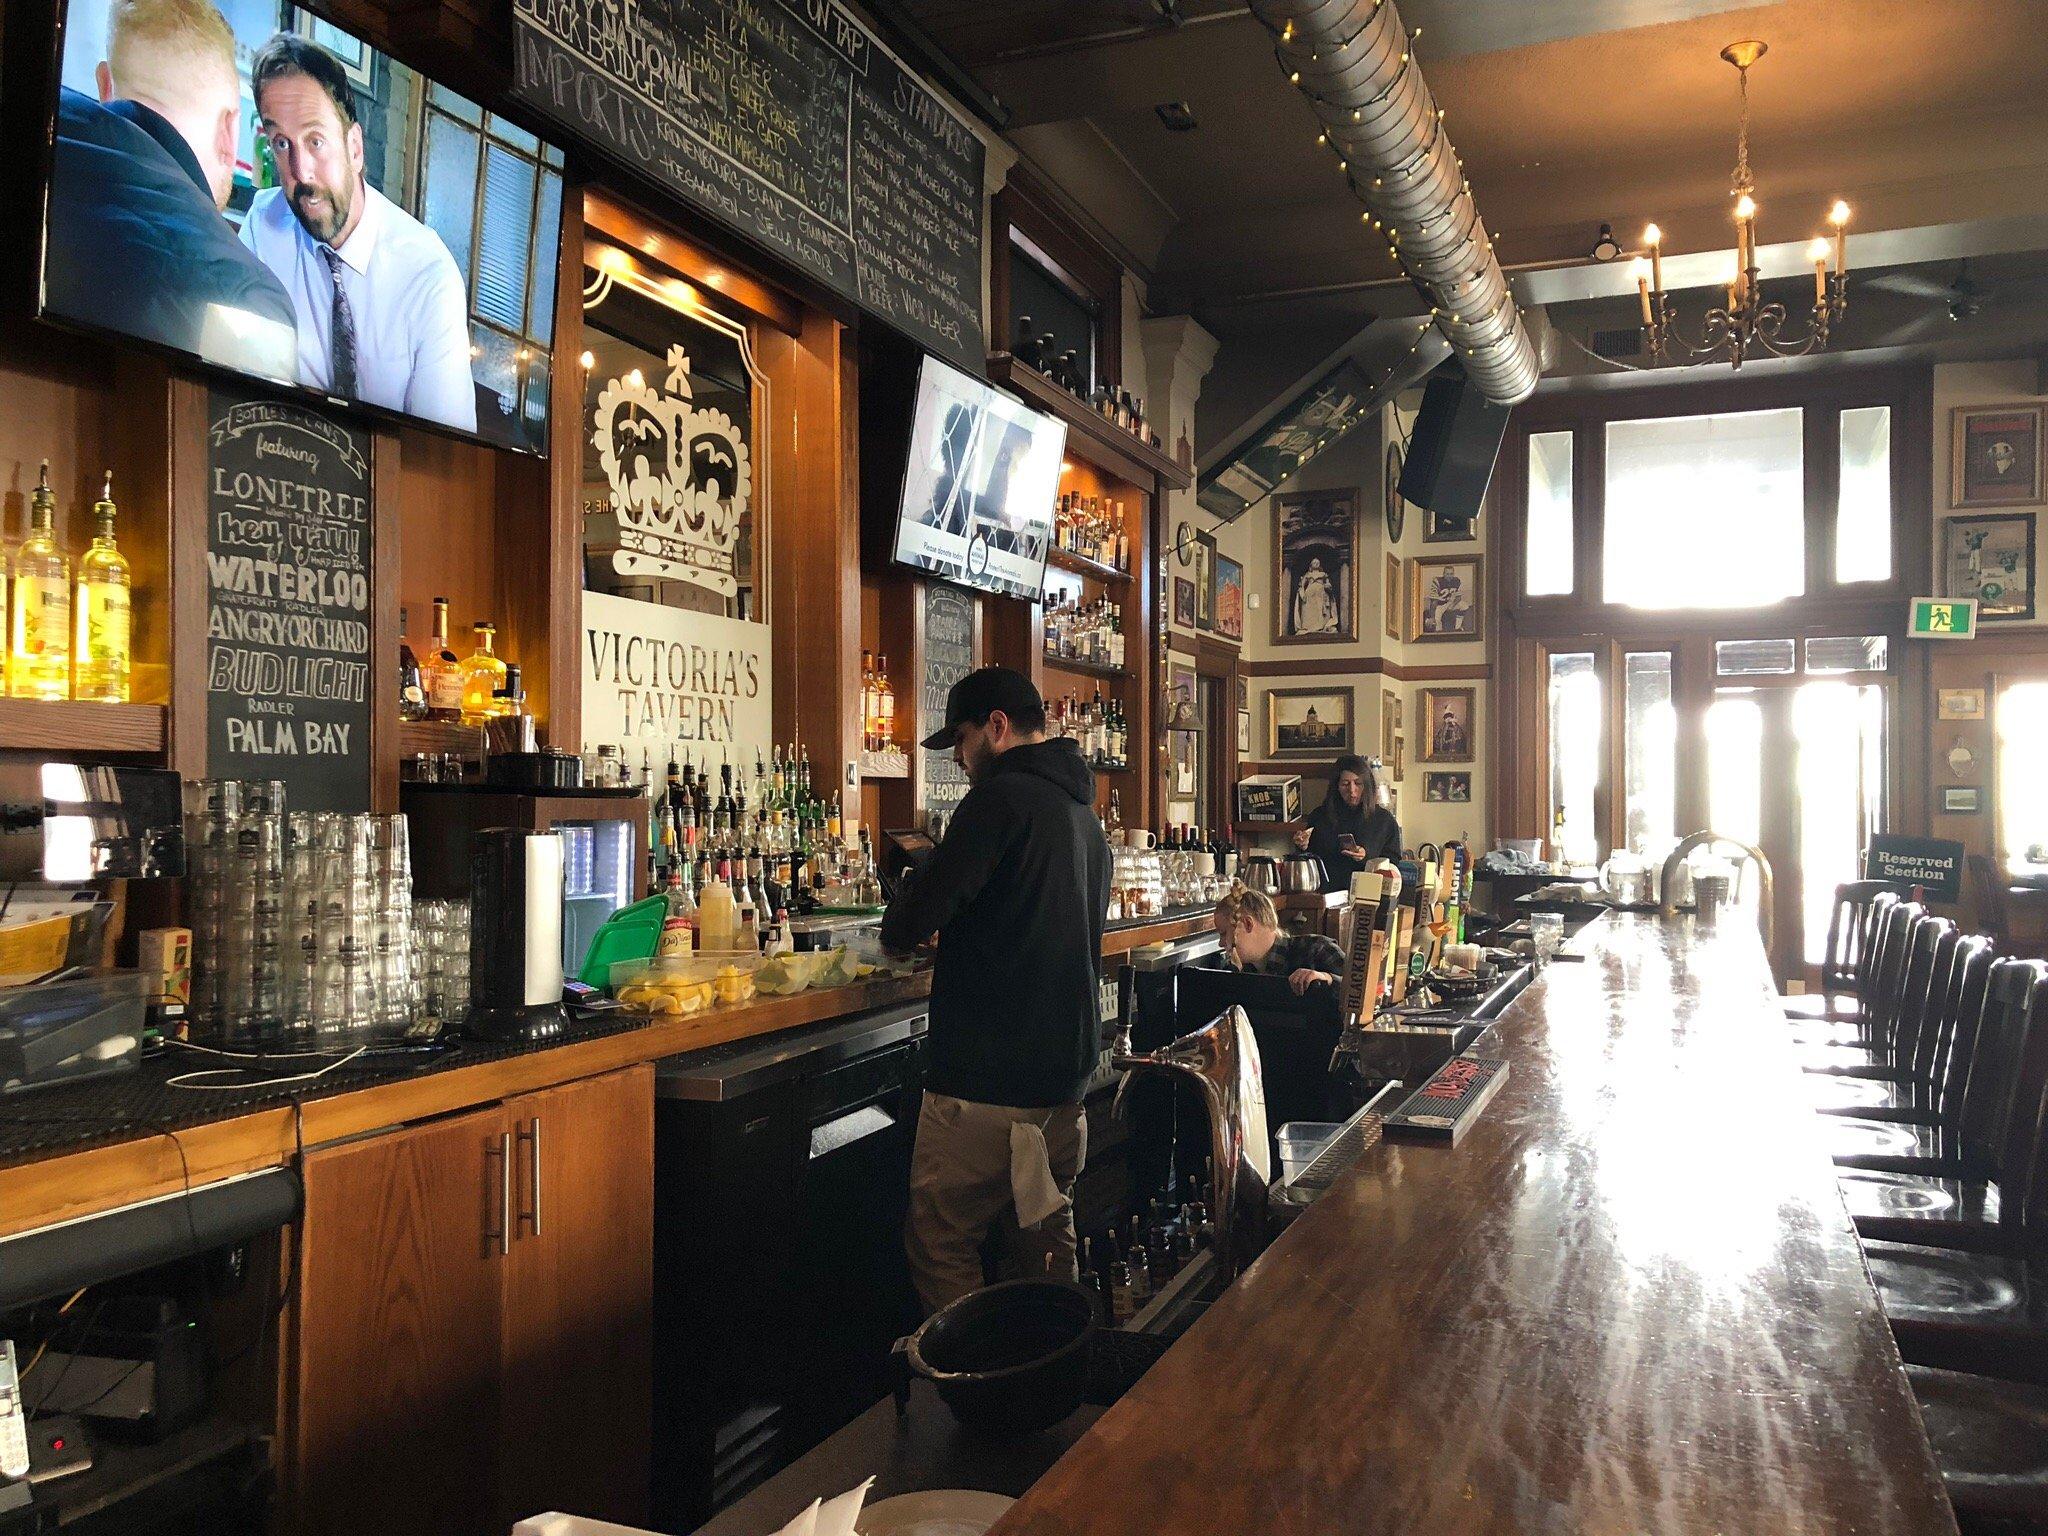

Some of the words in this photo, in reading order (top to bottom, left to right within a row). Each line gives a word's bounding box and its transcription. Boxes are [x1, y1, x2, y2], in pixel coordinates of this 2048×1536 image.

[832, 11, 864, 58] TAP
[586, 21, 665, 106] BRIDGE
[602, 8, 701, 104] NATIONAL
[756, 119, 787, 157] GATO
[255, 432, 321, 476] featuring
[214, 467, 368, 524] LONETREE
[218, 511, 284, 564] hey
[207, 551, 368, 611] WATERLOO
[208, 645, 284, 696] BUD
[286, 655, 368, 703] LIGHT
[586, 628, 759, 699] VICTORIA'S
[247, 697, 295, 717] RADLER
[617, 688, 735, 743] TAVERN
[226, 717, 299, 755] PALM
[304, 720, 350, 755] BAY
[1248, 791, 1270, 804] KNOB
[1449, 861, 1461, 905] LIGHT
[1878, 851, 1953, 869] Reserved
[1883, 864, 1944, 881] Section
